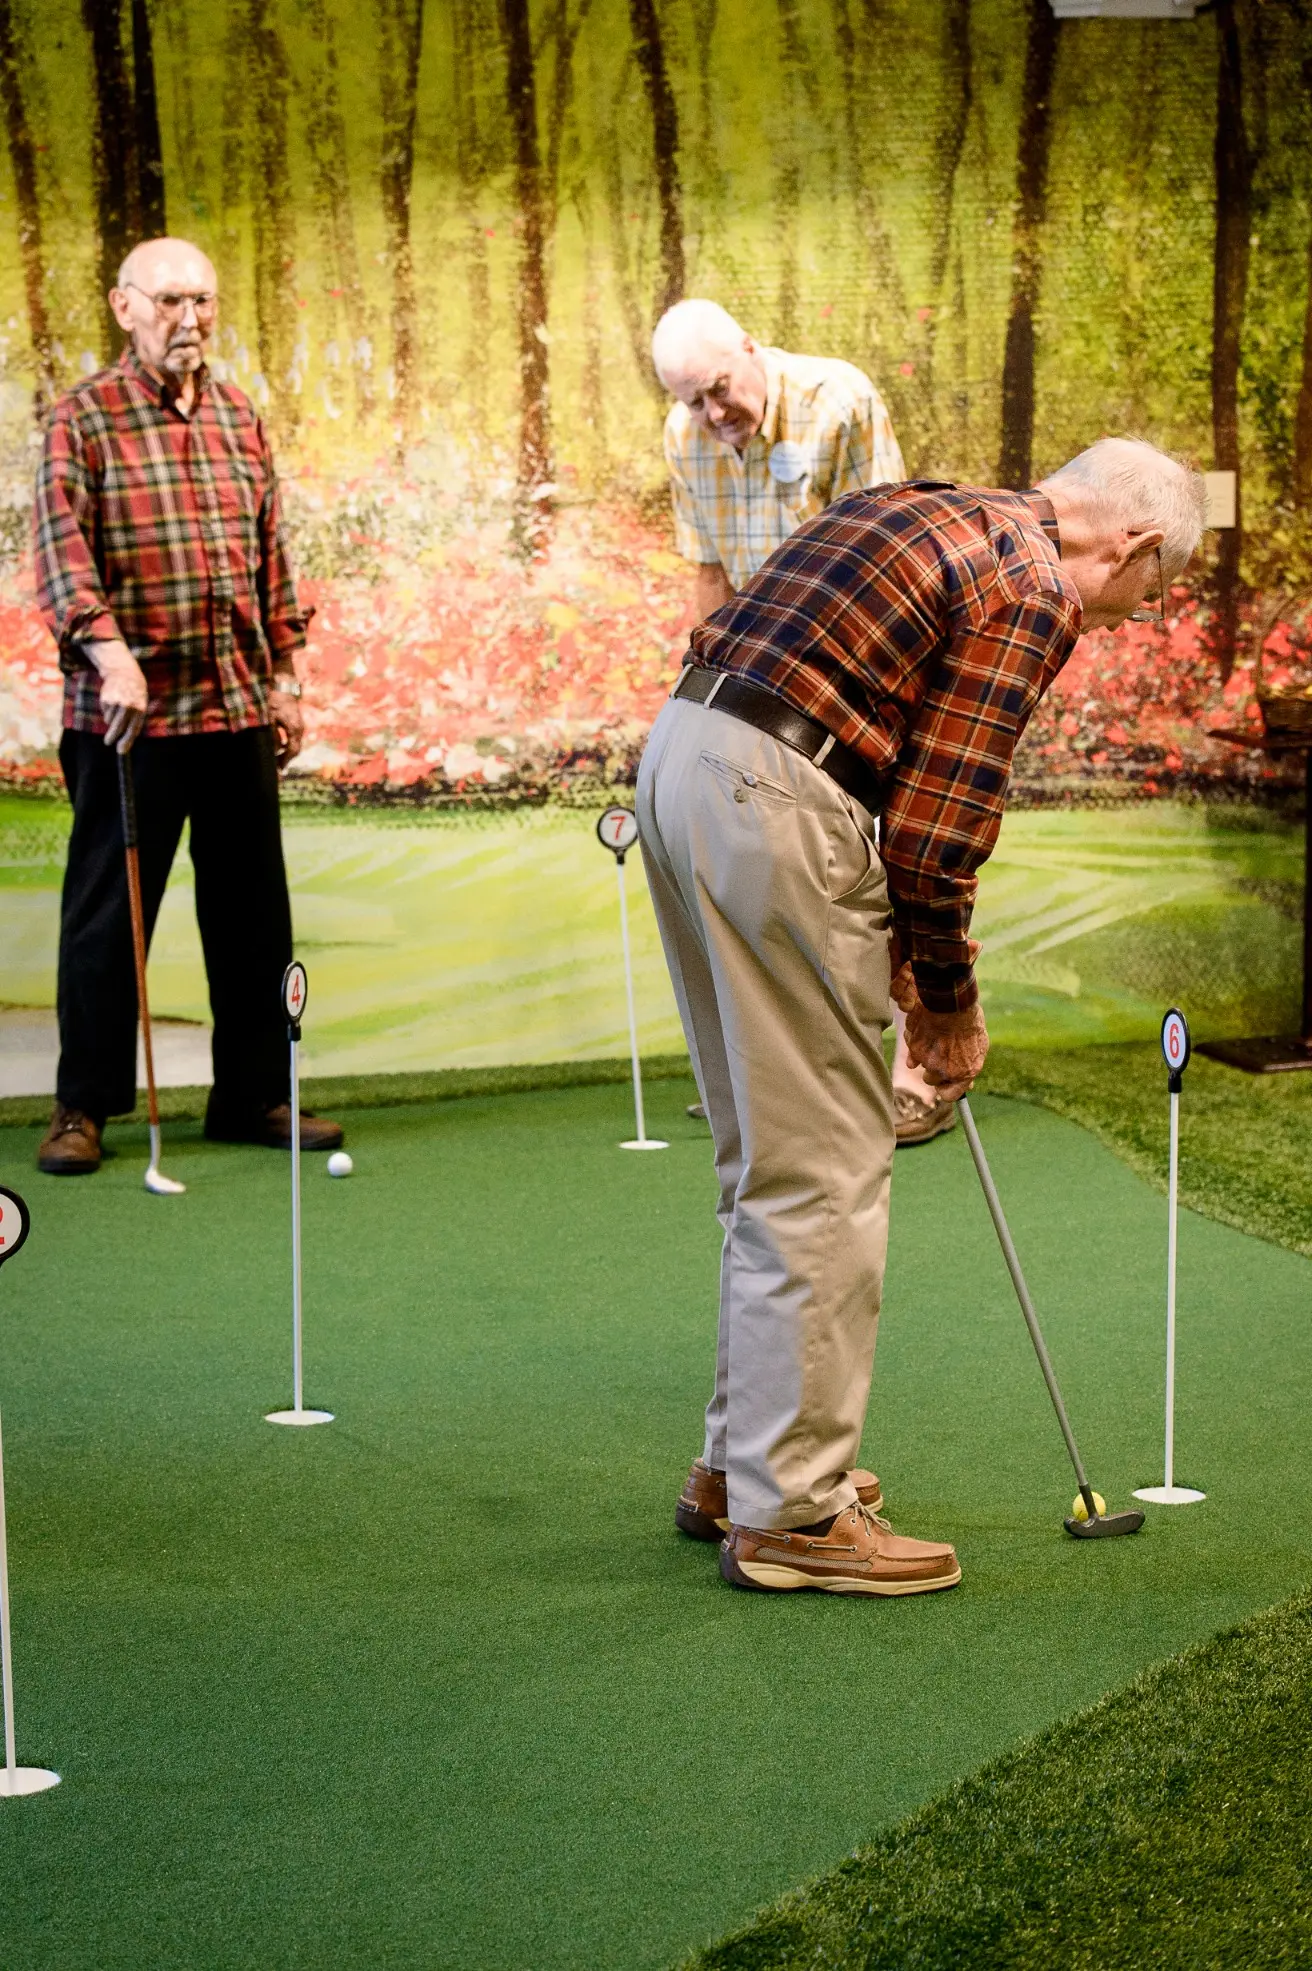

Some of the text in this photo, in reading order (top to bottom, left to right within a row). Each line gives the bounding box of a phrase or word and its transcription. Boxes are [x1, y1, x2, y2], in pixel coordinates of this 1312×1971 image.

[610, 815, 626, 840] 7
[291, 974, 301, 1008] 4
[1169, 1023, 1180, 1059] 6
